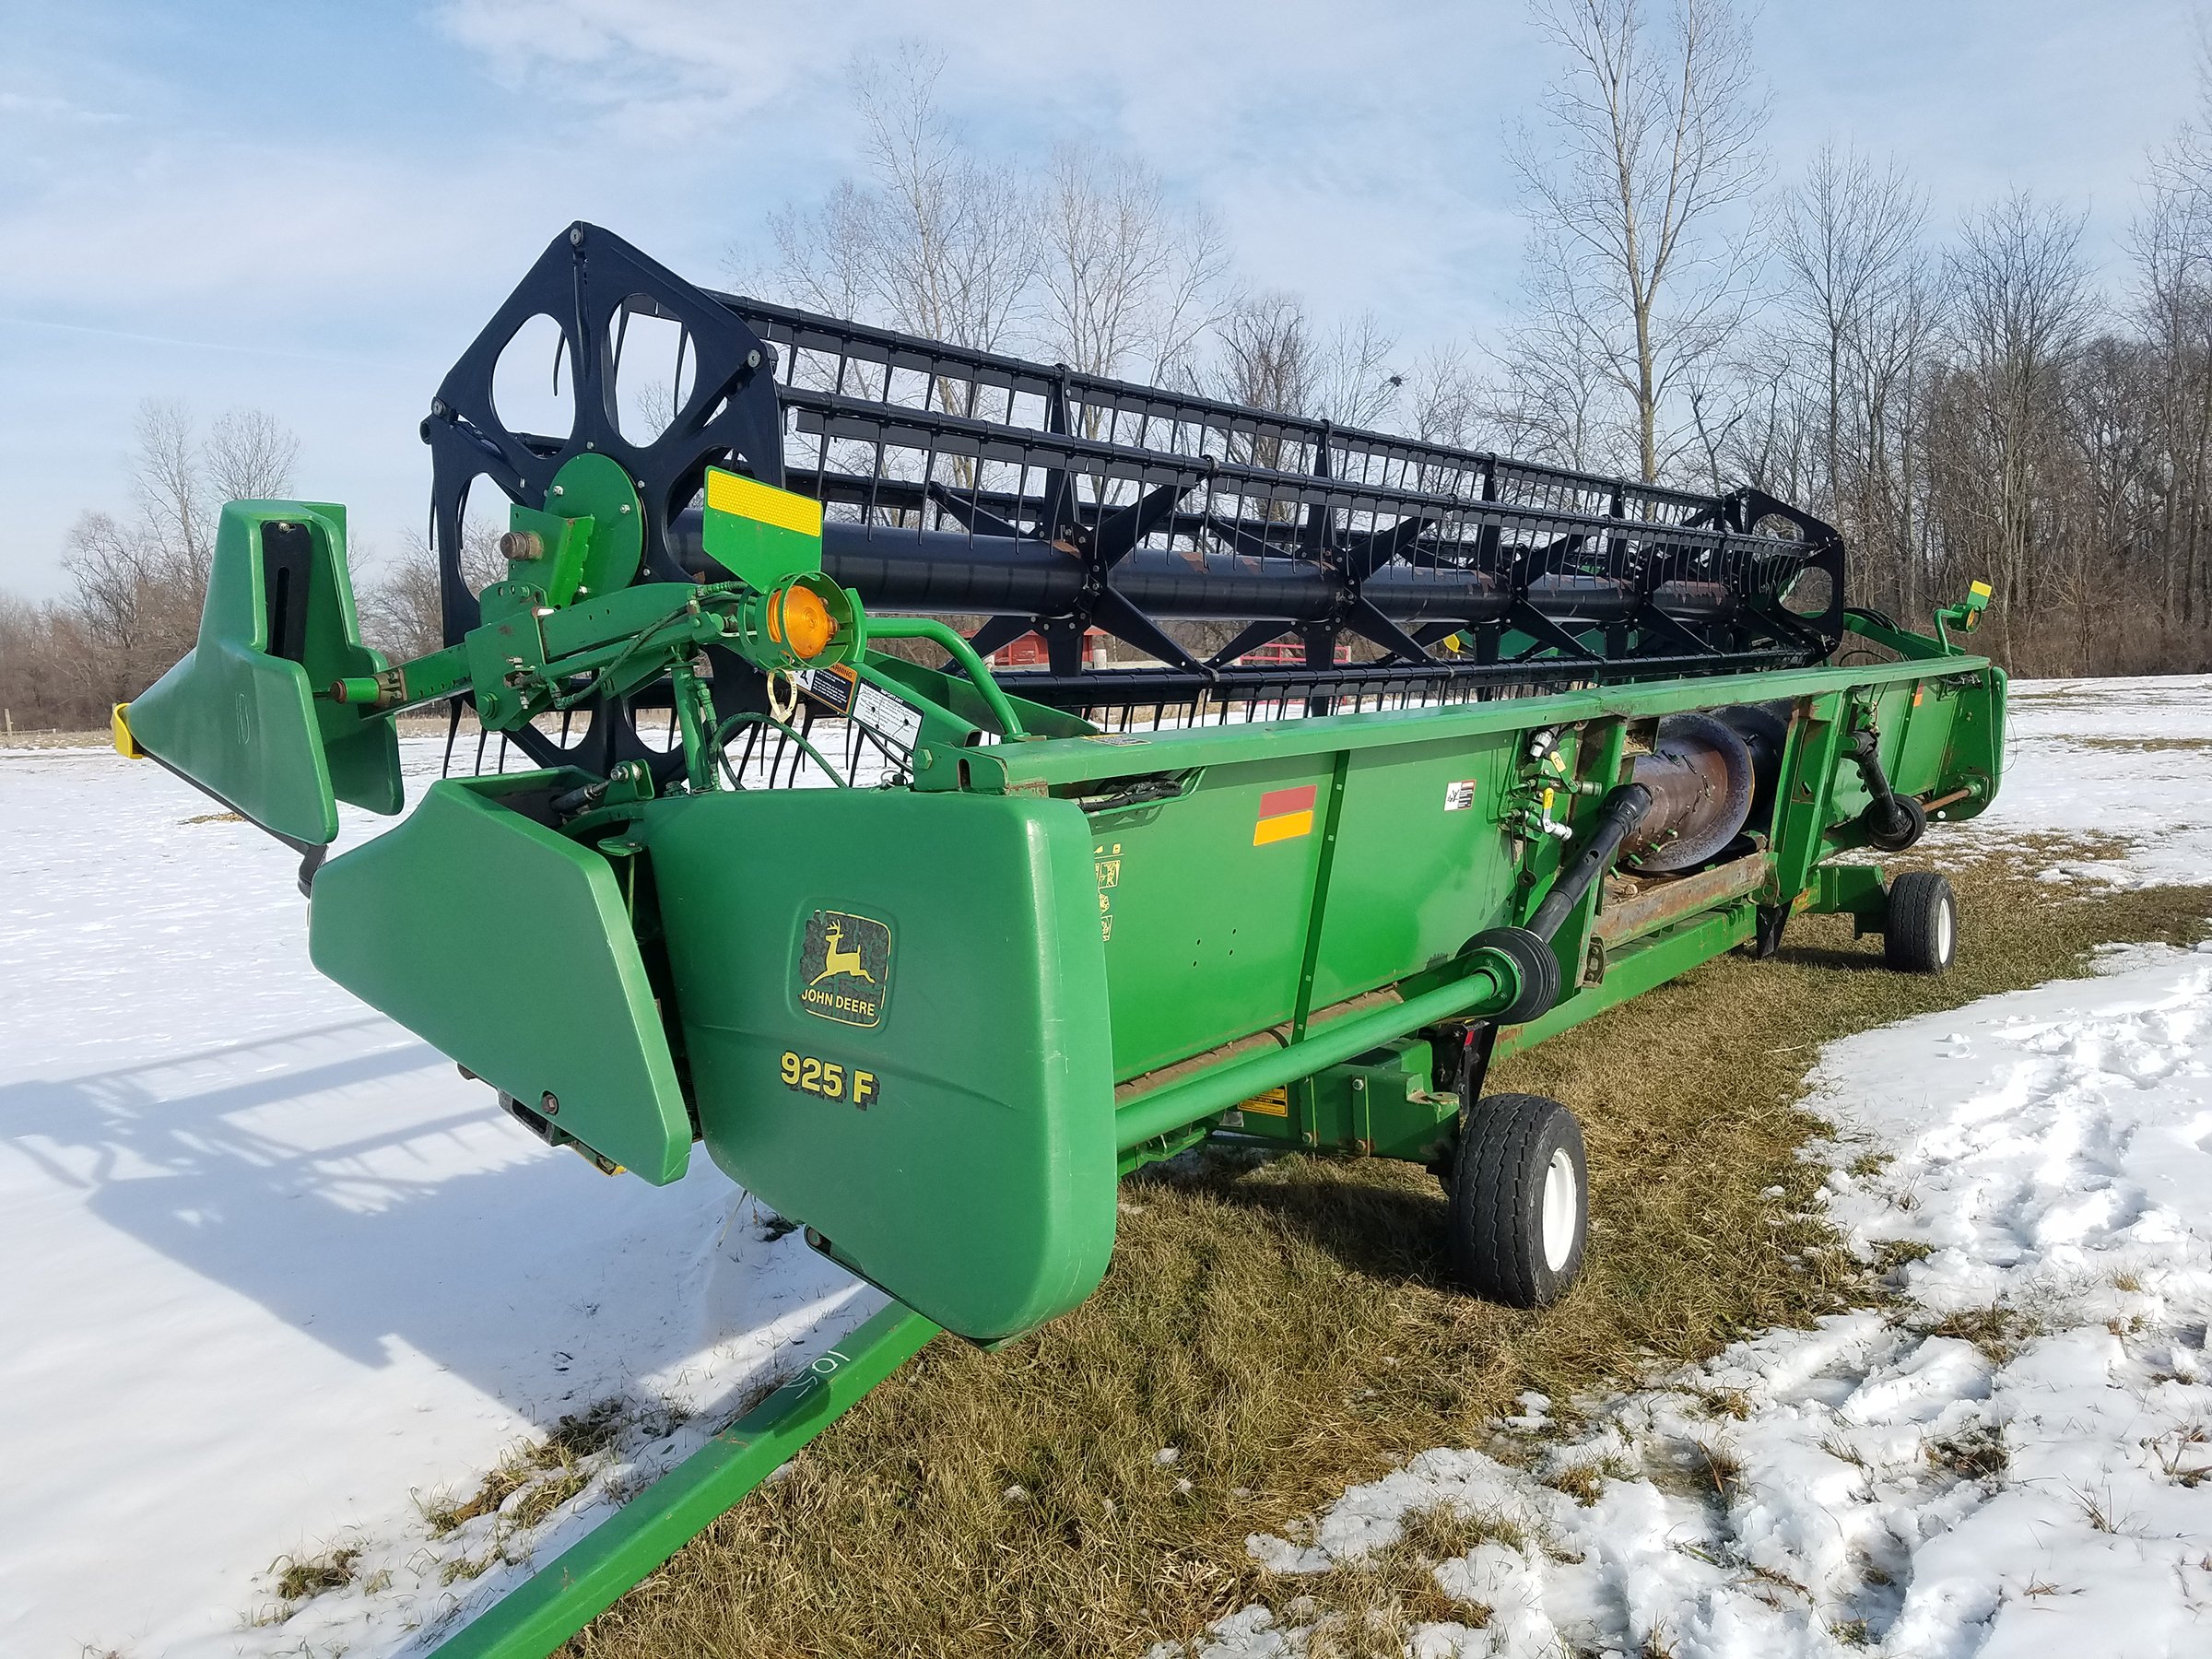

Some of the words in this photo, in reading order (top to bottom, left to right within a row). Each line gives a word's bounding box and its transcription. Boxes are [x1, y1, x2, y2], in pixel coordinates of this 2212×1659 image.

[831, 664, 853, 678] ARNING
[880, 688, 904, 705] IMPORTANT
[800, 988, 834, 1007] JOHN
[834, 994, 876, 1018] DEERE
[780, 1051, 845, 1100] 925
[852, 1069, 877, 1105] F
